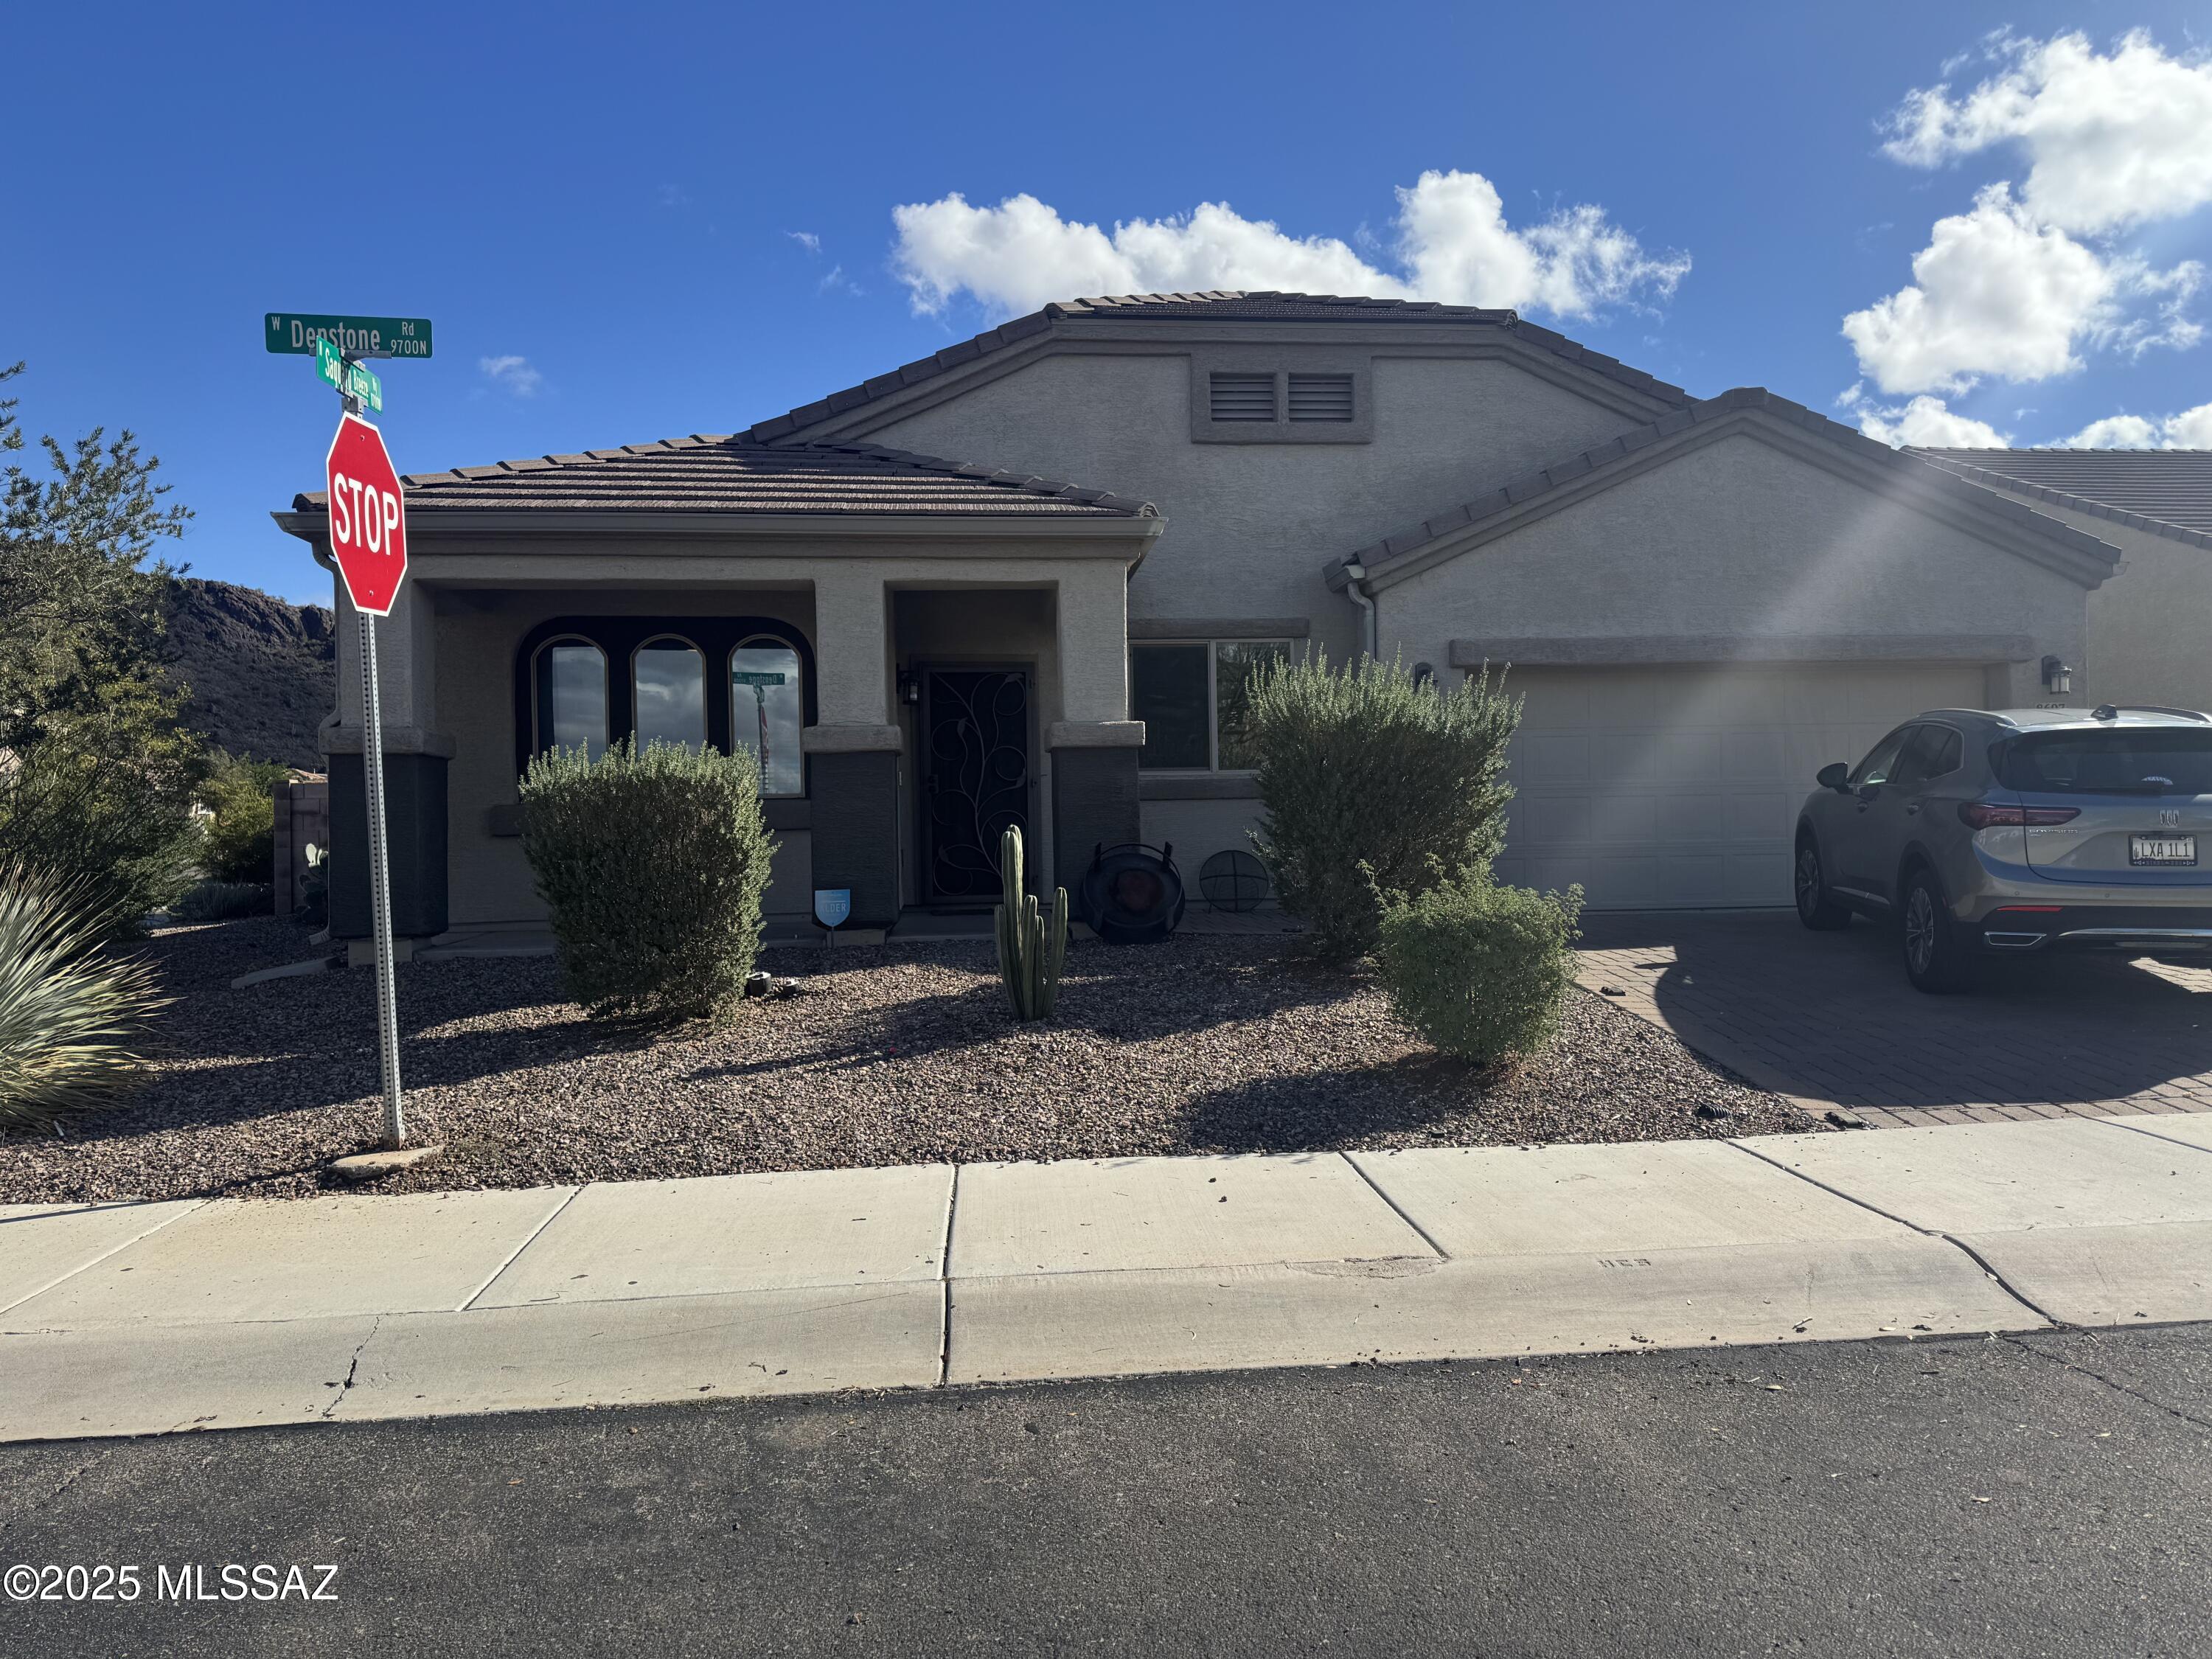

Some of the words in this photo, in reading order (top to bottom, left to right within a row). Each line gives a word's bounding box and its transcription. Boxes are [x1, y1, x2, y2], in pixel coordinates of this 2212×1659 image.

[271, 317, 280, 331] W
[291, 319, 380, 350] Denstone
[402, 321, 414, 336] Rd
[391, 340, 426, 355] 9700N
[353, 369, 369, 398] Breeze
[334, 473, 399, 555] STOP
[2141, 843, 2164, 858] LXA
[2168, 843, 2190, 858] 1L1
